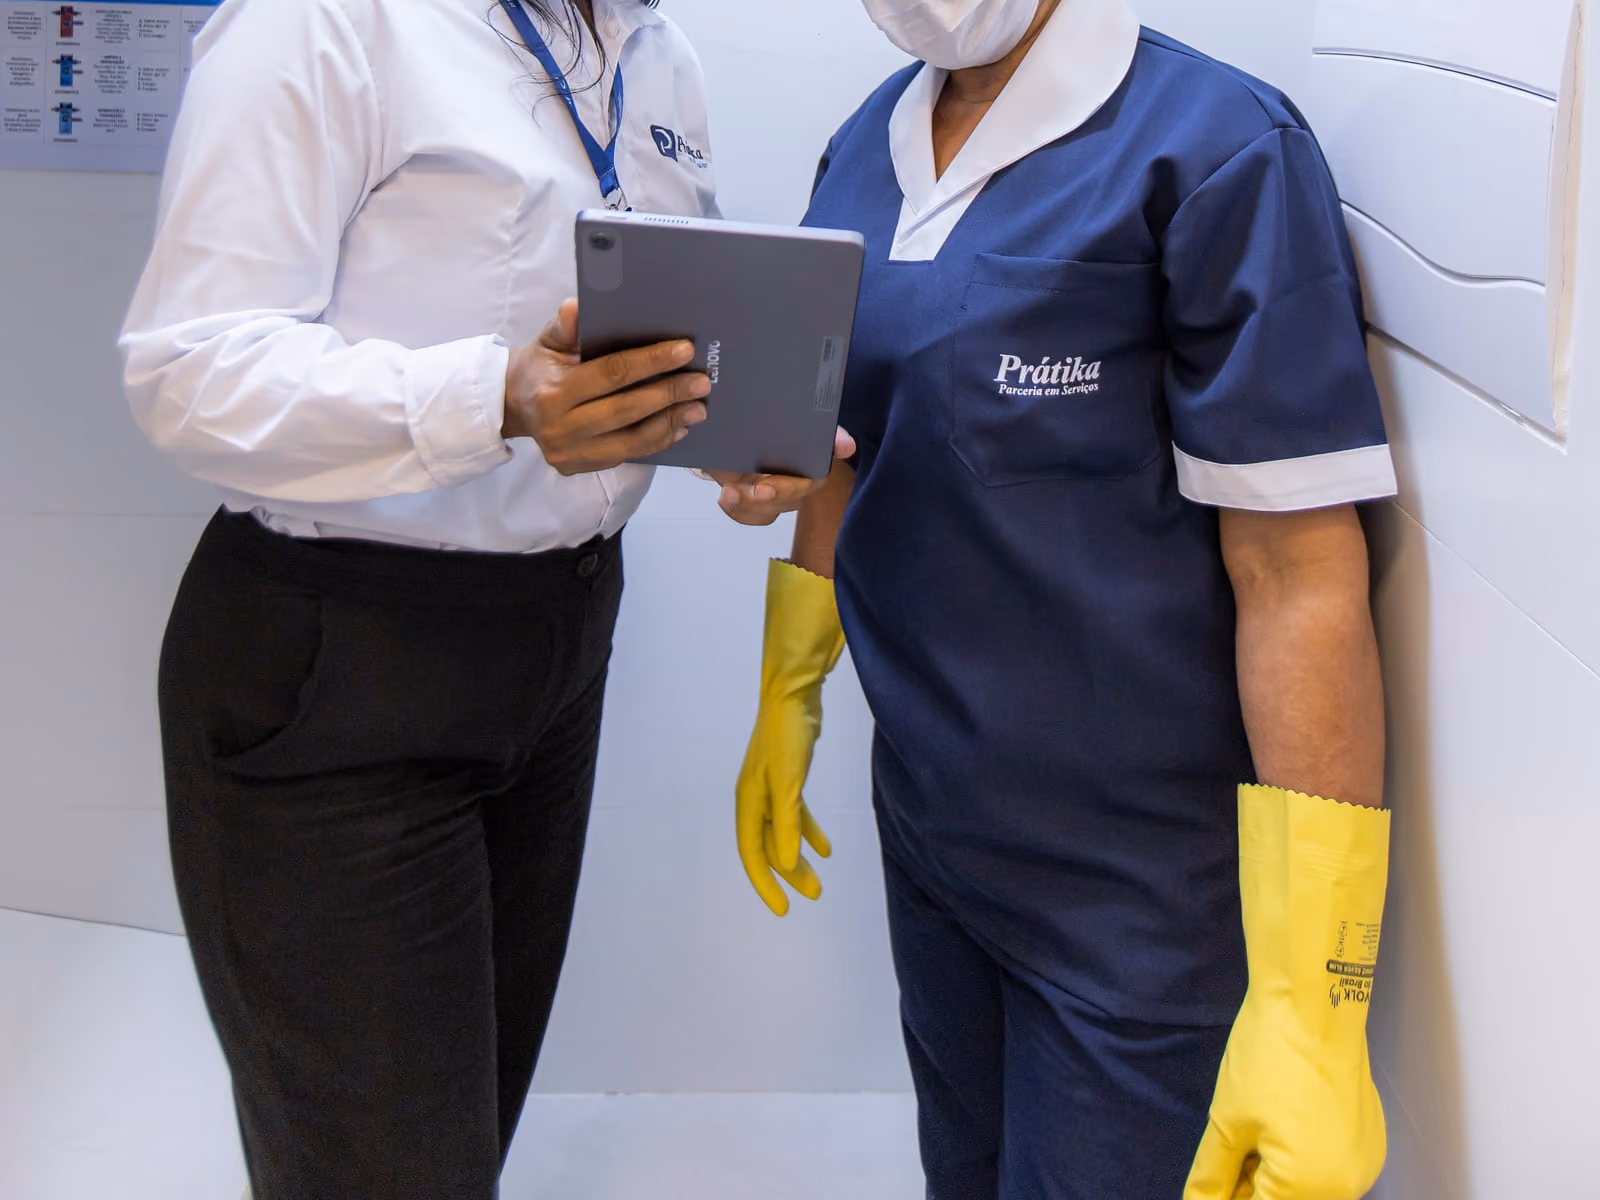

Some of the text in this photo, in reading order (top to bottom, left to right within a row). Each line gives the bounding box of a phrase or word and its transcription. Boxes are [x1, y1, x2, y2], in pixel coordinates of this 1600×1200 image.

[993, 353, 1101, 384] Prátika
[998, 382, 1099, 396] Parceria em Serviços
[1339, 978, 1362, 989] Brasil
